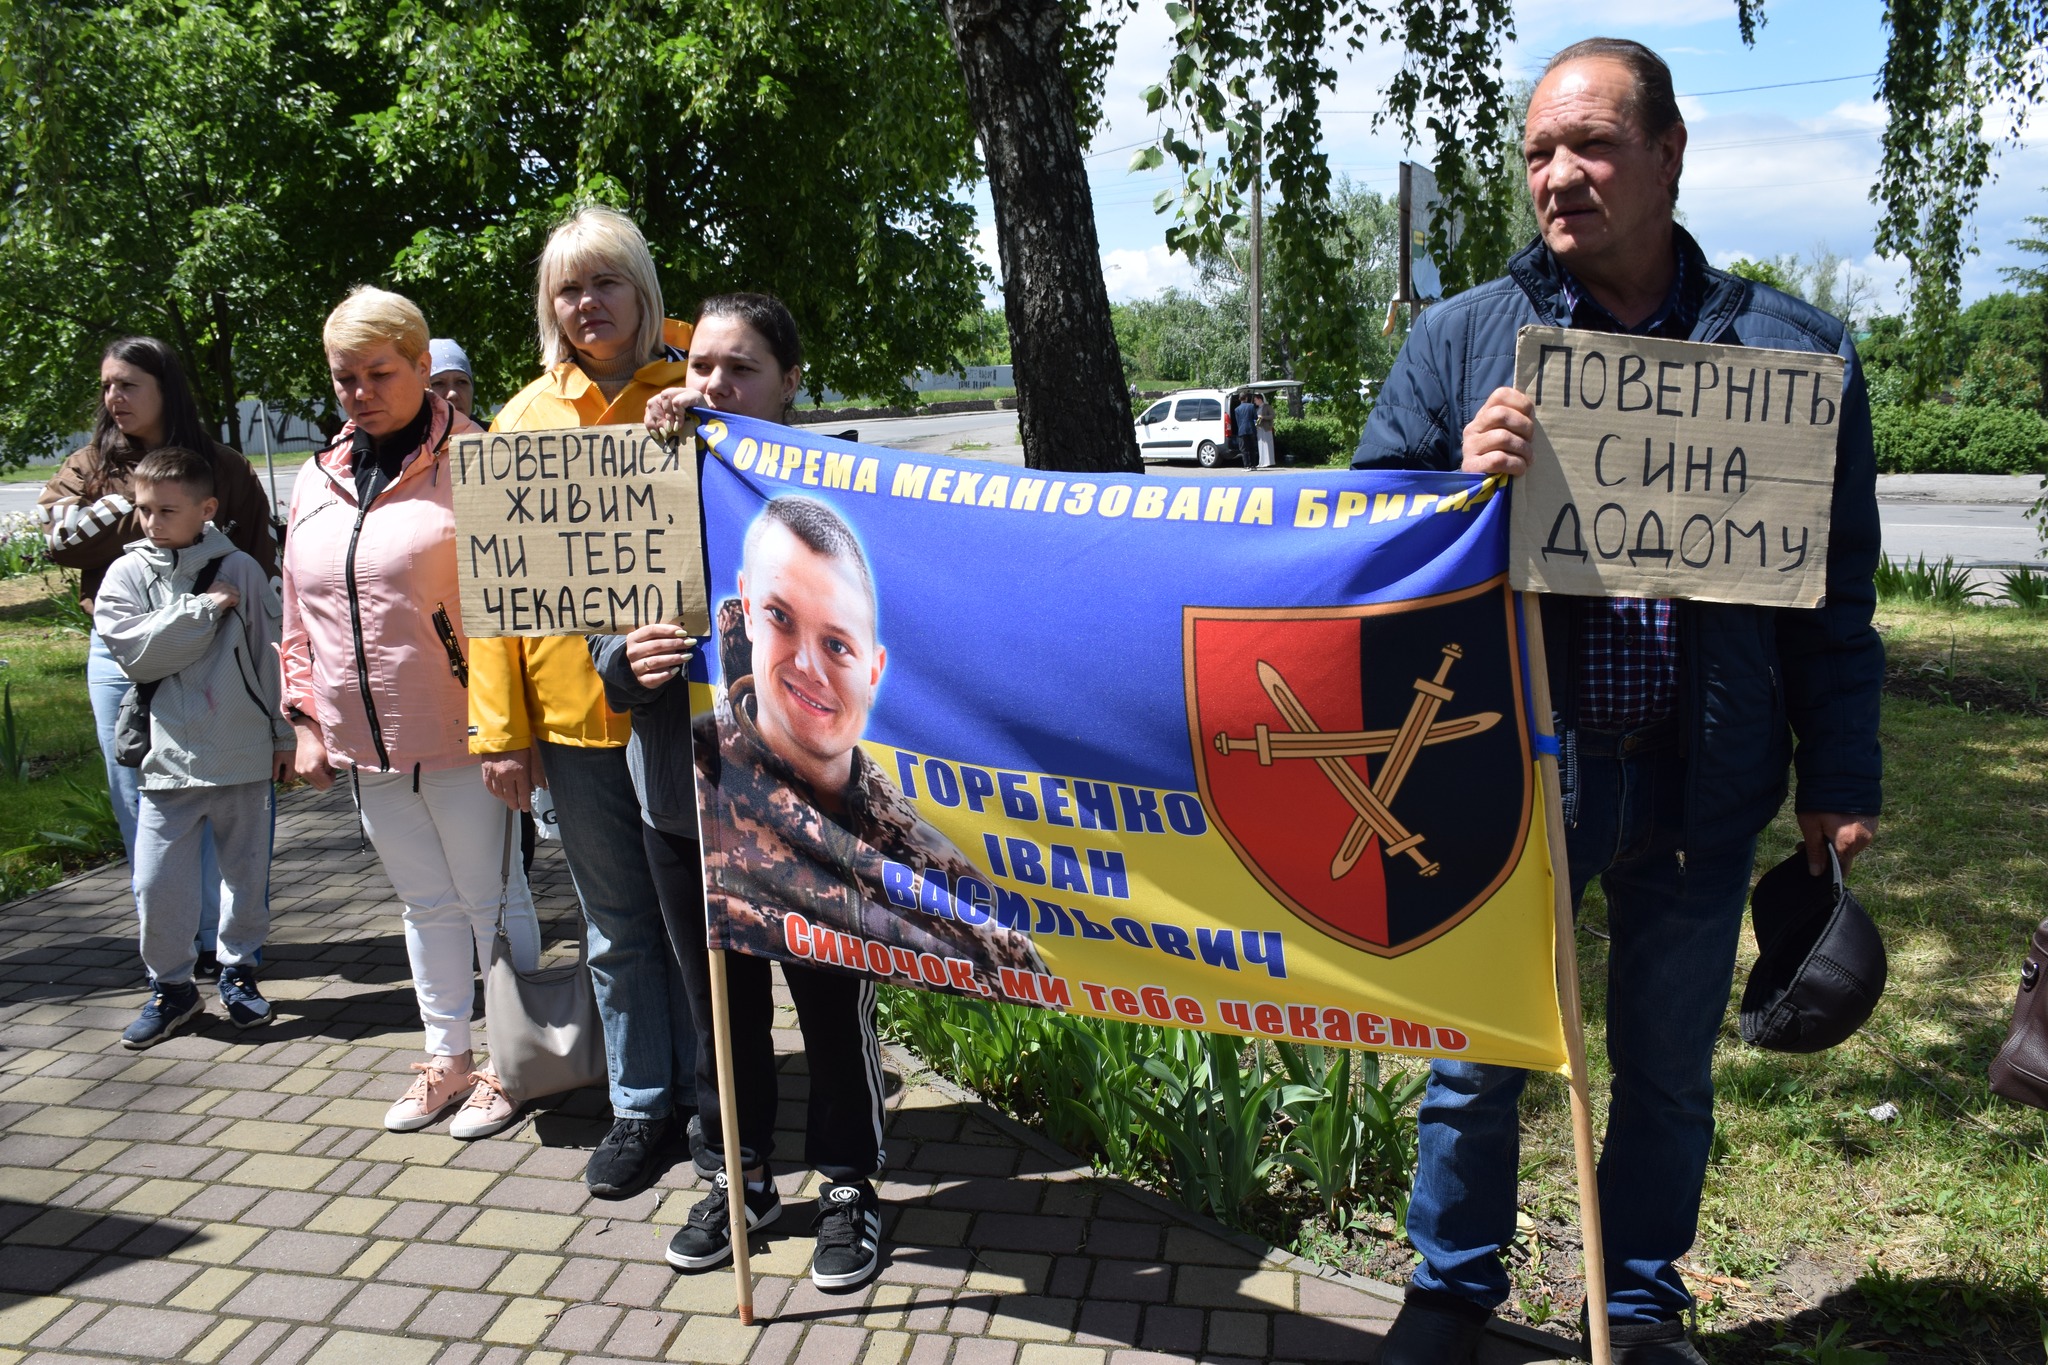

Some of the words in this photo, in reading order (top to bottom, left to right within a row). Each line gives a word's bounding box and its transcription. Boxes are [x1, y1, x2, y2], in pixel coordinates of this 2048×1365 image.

[1535, 344, 1835, 425] ПОВЕРНІТЬ
[459, 429, 680, 486] ПОВЕРТАЙСЯ
[732, 437, 880, 494] ОКРЕМА
[890, 462, 1273, 526] МЕХАНІЗОВАНА
[1594, 434, 1748, 493] СИНА
[505, 483, 674, 525] ЖИВИМ,
[1541, 502, 1809, 572] ДОДОМУ
[470, 533, 528, 578] МИ
[558, 529, 667, 577] ТЕБЕ
[893, 749, 1210, 838] ГОРБЕНКО
[982, 832, 1131, 900] ІВАН
[881, 859, 1288, 980] ВАСИЛЬОВИЧ
[783, 911, 992, 997] Синочок,
[997, 966, 1074, 1008] ми
[1078, 981, 1207, 1026] тебе
[1216, 999, 1471, 1053] чекаємо
